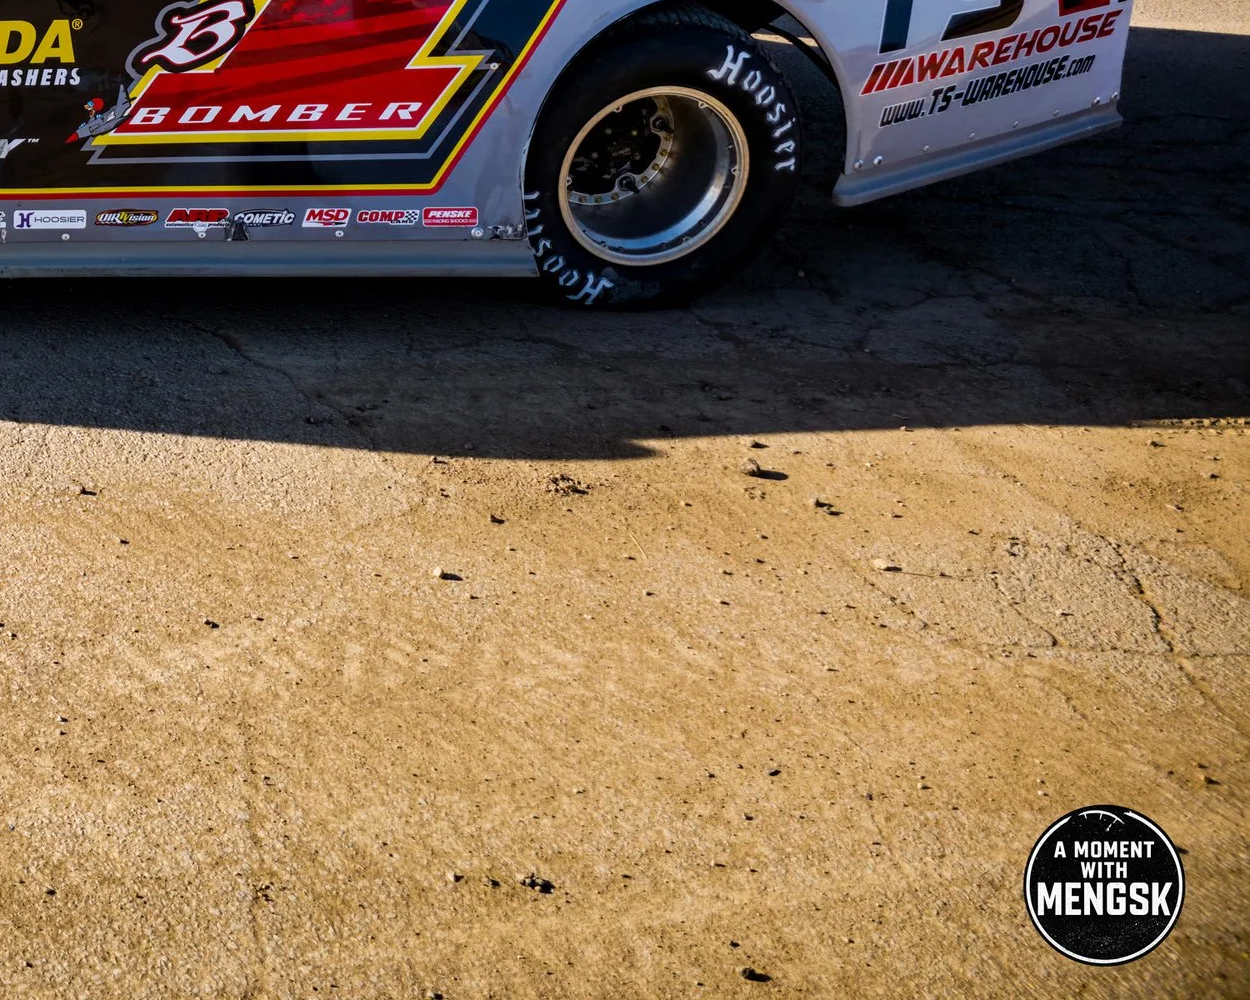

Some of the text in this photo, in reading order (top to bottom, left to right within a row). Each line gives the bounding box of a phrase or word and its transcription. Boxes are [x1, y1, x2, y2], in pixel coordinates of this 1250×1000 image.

[141, 0, 245, 64] B
[917, 9, 1124, 82] WAREHOUSE
[129, 102, 424, 126] BOMBER
[707, 44, 796, 171] Hoosier
[34, 215, 85, 223] HOOSIER
[166, 209, 228, 223] ARP
[234, 210, 295, 224] COMETIC
[306, 209, 349, 223] MSD
[358, 211, 406, 222] COMP
[428, 210, 472, 218] PENSKE
